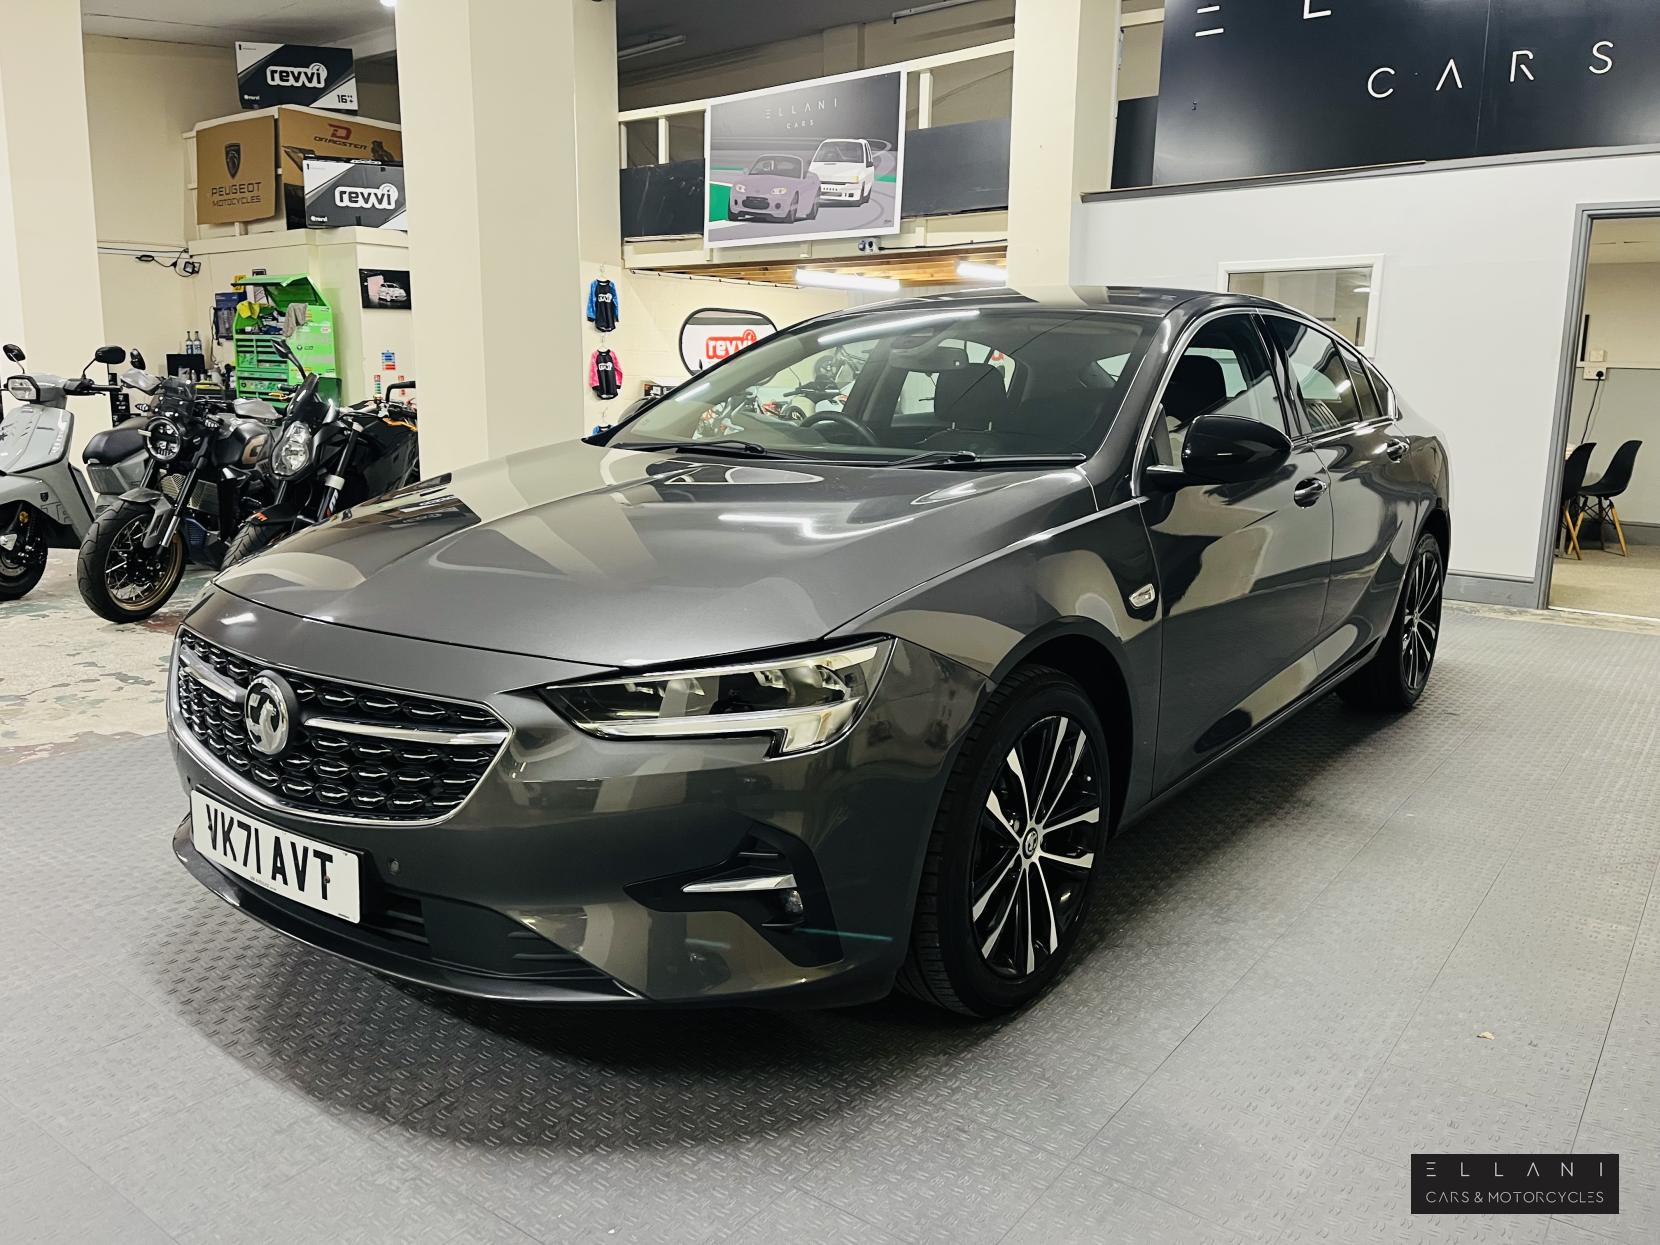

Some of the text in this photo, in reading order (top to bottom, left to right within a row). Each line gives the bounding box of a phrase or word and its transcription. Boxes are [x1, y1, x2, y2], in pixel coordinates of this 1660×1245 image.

[268, 65, 323, 86] revvi
[1366, 40, 1614, 99] CARS
[764, 98, 838, 119] ELLANI
[313, 136, 368, 151] DRAGSTER
[211, 181, 262, 197] PEUGEOT
[338, 187, 393, 207] revvi
[205, 803, 334, 901] VK71 AVT
